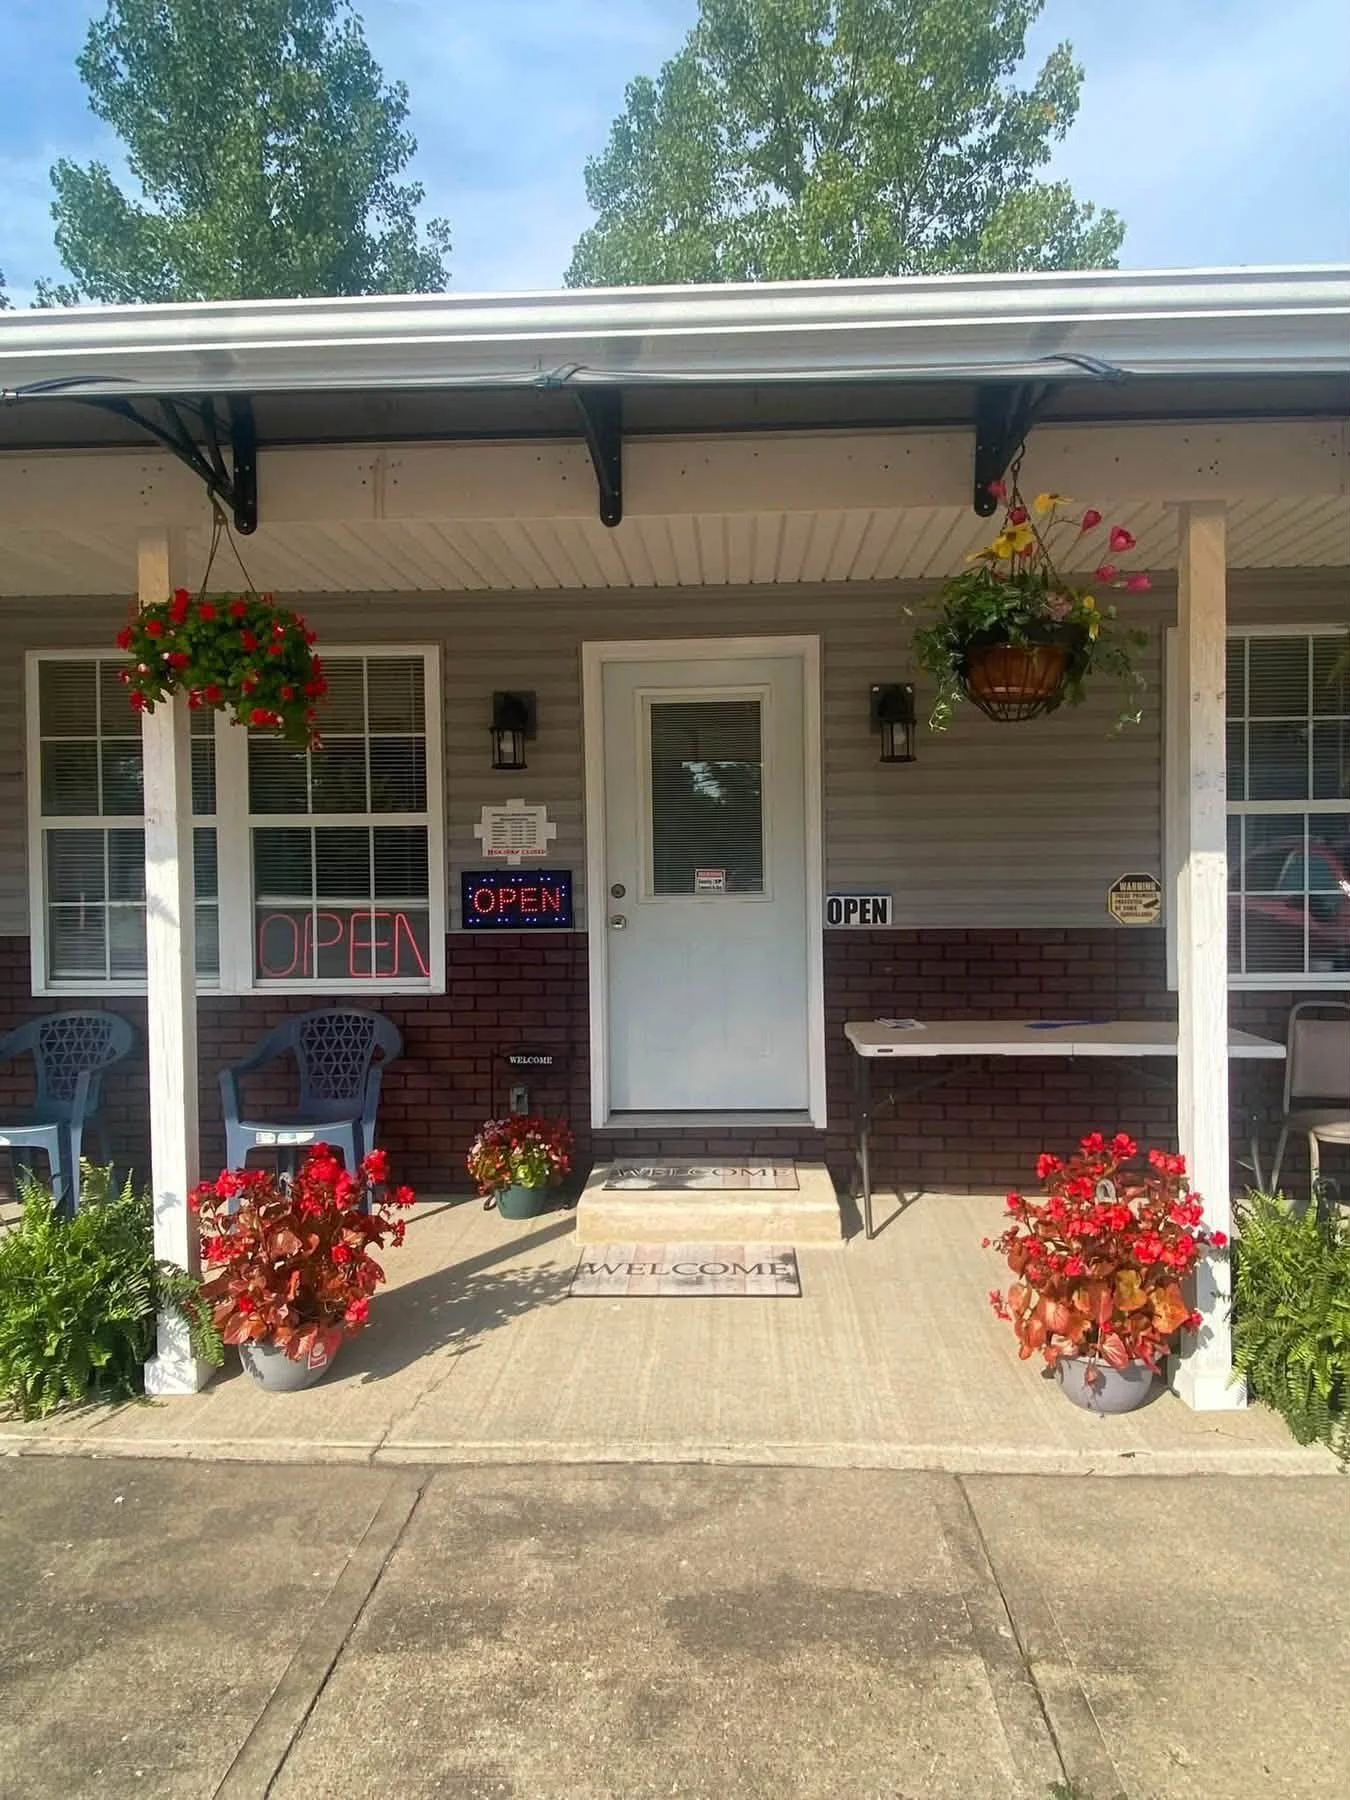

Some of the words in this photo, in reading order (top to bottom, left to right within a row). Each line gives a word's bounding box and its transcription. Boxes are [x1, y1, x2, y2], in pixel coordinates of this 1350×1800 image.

[473, 887, 561, 913] OPEN
[827, 897, 888, 925] OPEN
[259, 912, 431, 977] OPEN
[509, 1056, 553, 1064] WELCOME
[617, 1167, 791, 1177] WELCOME
[583, 1262, 793, 1276] WELCOME
